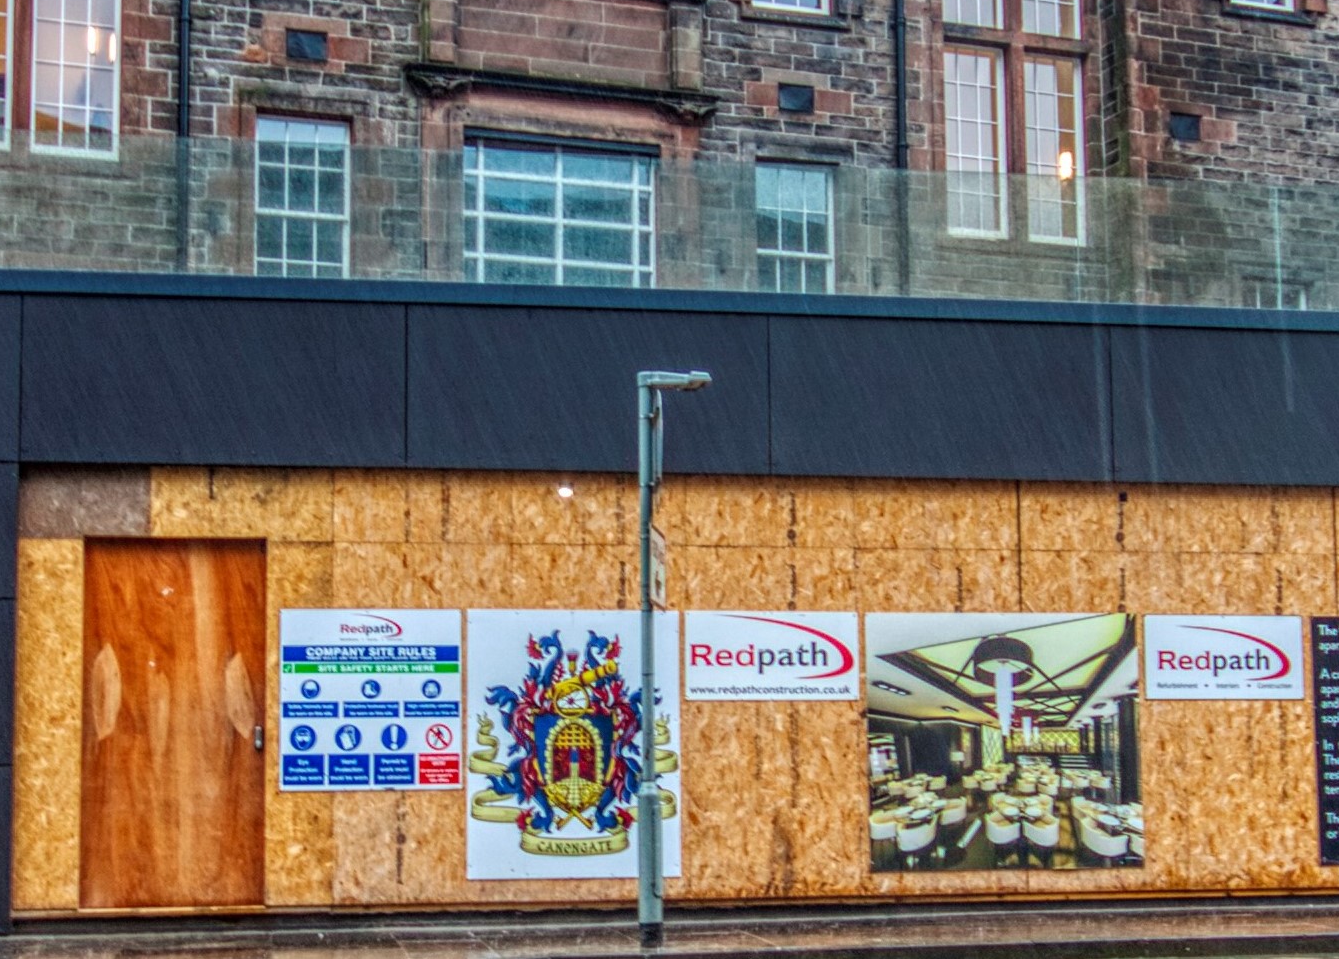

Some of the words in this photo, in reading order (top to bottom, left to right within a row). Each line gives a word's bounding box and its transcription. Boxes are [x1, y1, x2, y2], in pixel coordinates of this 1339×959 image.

[339, 624, 394, 636] Redpath
[1317, 624, 1338, 636] The
[306, 647, 366, 657] COMPANY
[368, 647, 394, 657] SITE
[398, 647, 436, 657] RULES
[689, 642, 829, 674] Redpath
[1157, 649, 1270, 677] Redpath
[318, 664, 337, 672] SITE
[340, 664, 374, 672] SAFETY
[376, 664, 409, 672] STARTS
[411, 664, 435, 672] HERE
[1320, 668, 1330, 679] A
[690, 685, 850, 696] www.redpathconstruction.co.uk
[1320, 697, 1339, 708] and
[1323, 739, 1334, 751] In
[1326, 831, 1338, 839] or
[537, 840, 612, 853] CANONGATE
